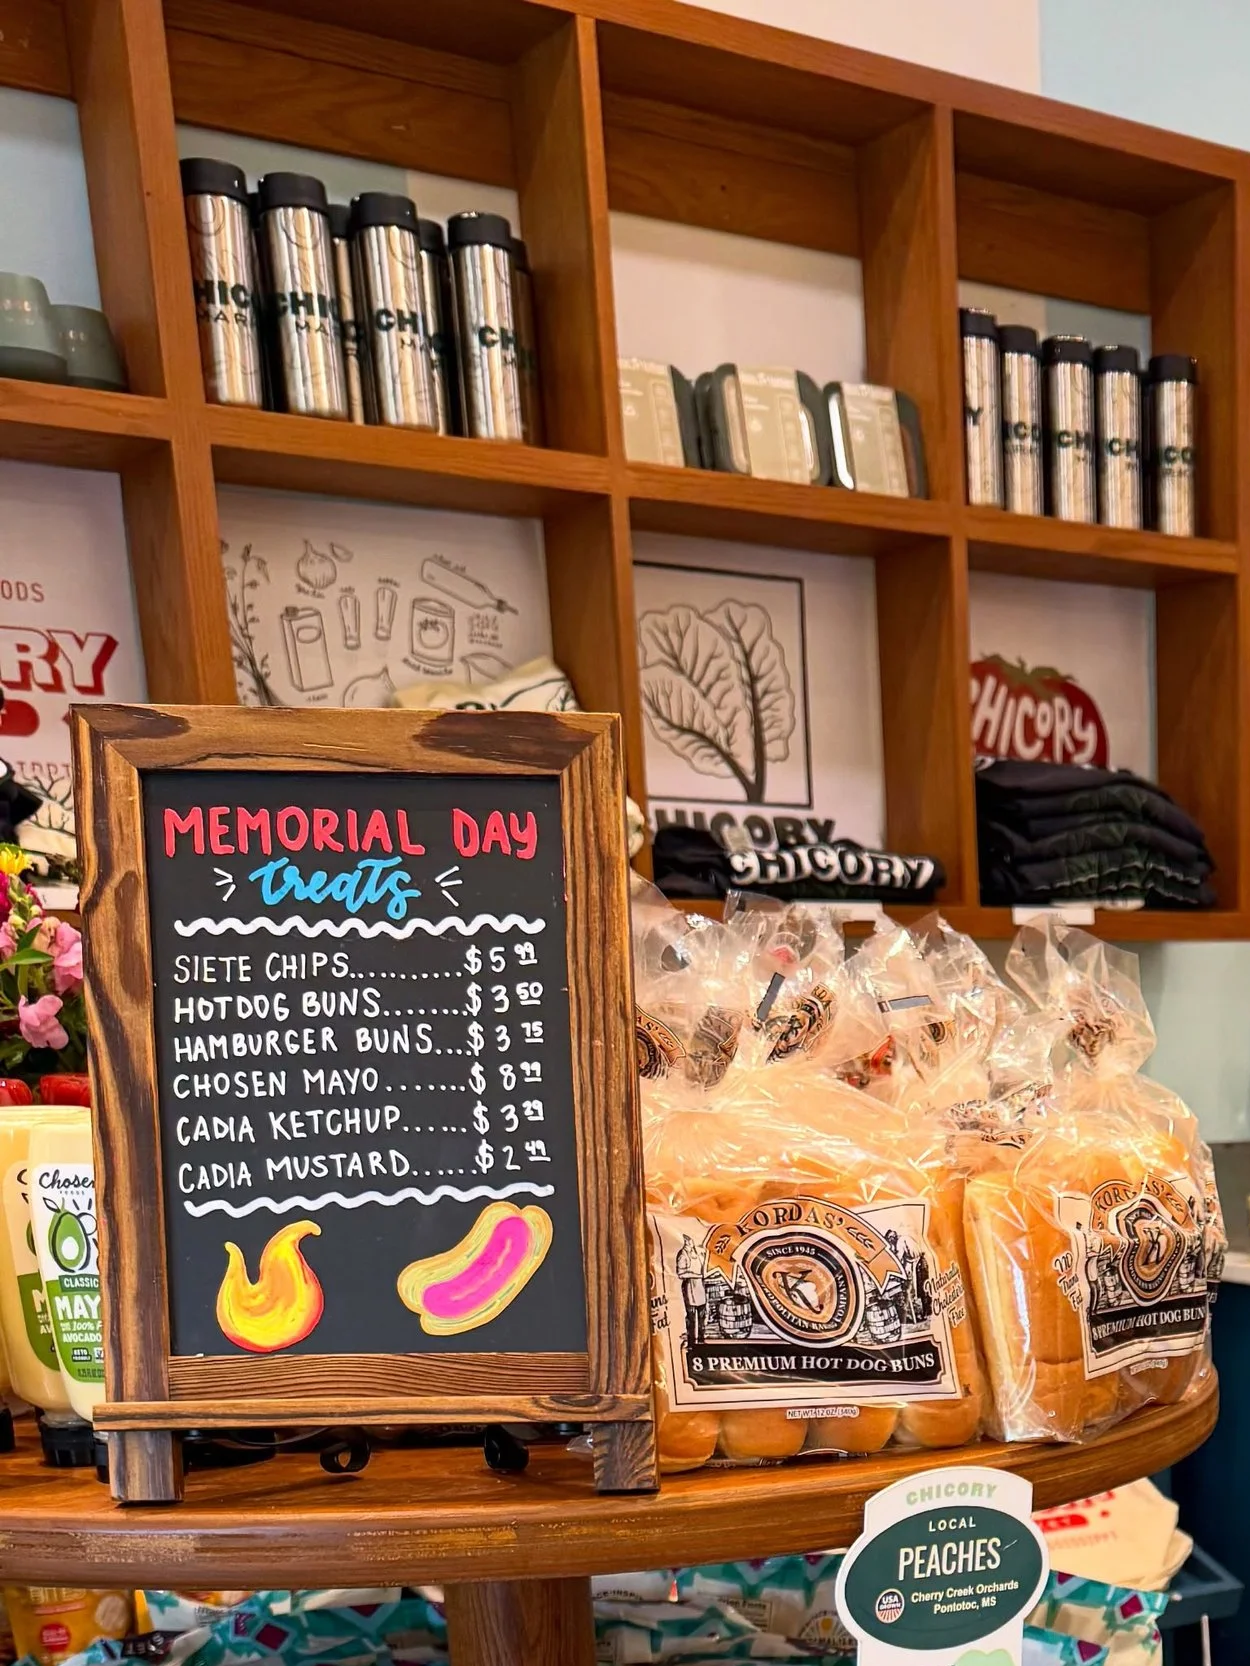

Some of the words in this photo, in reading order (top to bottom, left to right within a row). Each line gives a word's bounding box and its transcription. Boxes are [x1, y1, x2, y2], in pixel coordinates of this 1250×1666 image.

[164, 806, 425, 857] MEMORIAL
[453, 808, 537, 859] DAY
[249, 856, 421, 919] treats
[174, 955, 251, 983] SIETE
[175, 993, 289, 1023] HOTDOG
[174, 1027, 337, 1062] HAMBURGER
[173, 1071, 286, 1098] CHOSEN
[177, 1116, 255, 1146] CADIA
[179, 1162, 251, 1193] CADIA
[766, 1245, 793, 1257] SINCE
[795, 1246, 816, 1256] 1945
[64, 1277, 99, 1289] CLASSIC
[1092, 1326, 1098, 1341] 8
[1136, 1312, 1157, 1328] HOT
[1159, 1309, 1182, 1323] DOG
[692, 1357, 703, 1372] 8
[708, 1355, 797, 1372] PREMIUM
[801, 1355, 843, 1371] HOT
[847, 1358, 889, 1373] DOG
[890, 1353, 935, 1374] BUNS
[906, 1482, 997, 1505] CHICORY
[929, 1517, 976, 1532] LOCAL
[898, 1538, 1001, 1581] PEACHES
[881, 1596, 898, 1604] USA
[911, 1588, 944, 1603] Cherry
[946, 1585, 974, 1599] Creek
[976, 1580, 1019, 1595] Orchards
[934, 1599, 980, 1614] Pontotoc,
[982, 1597, 996, 1608] MS
